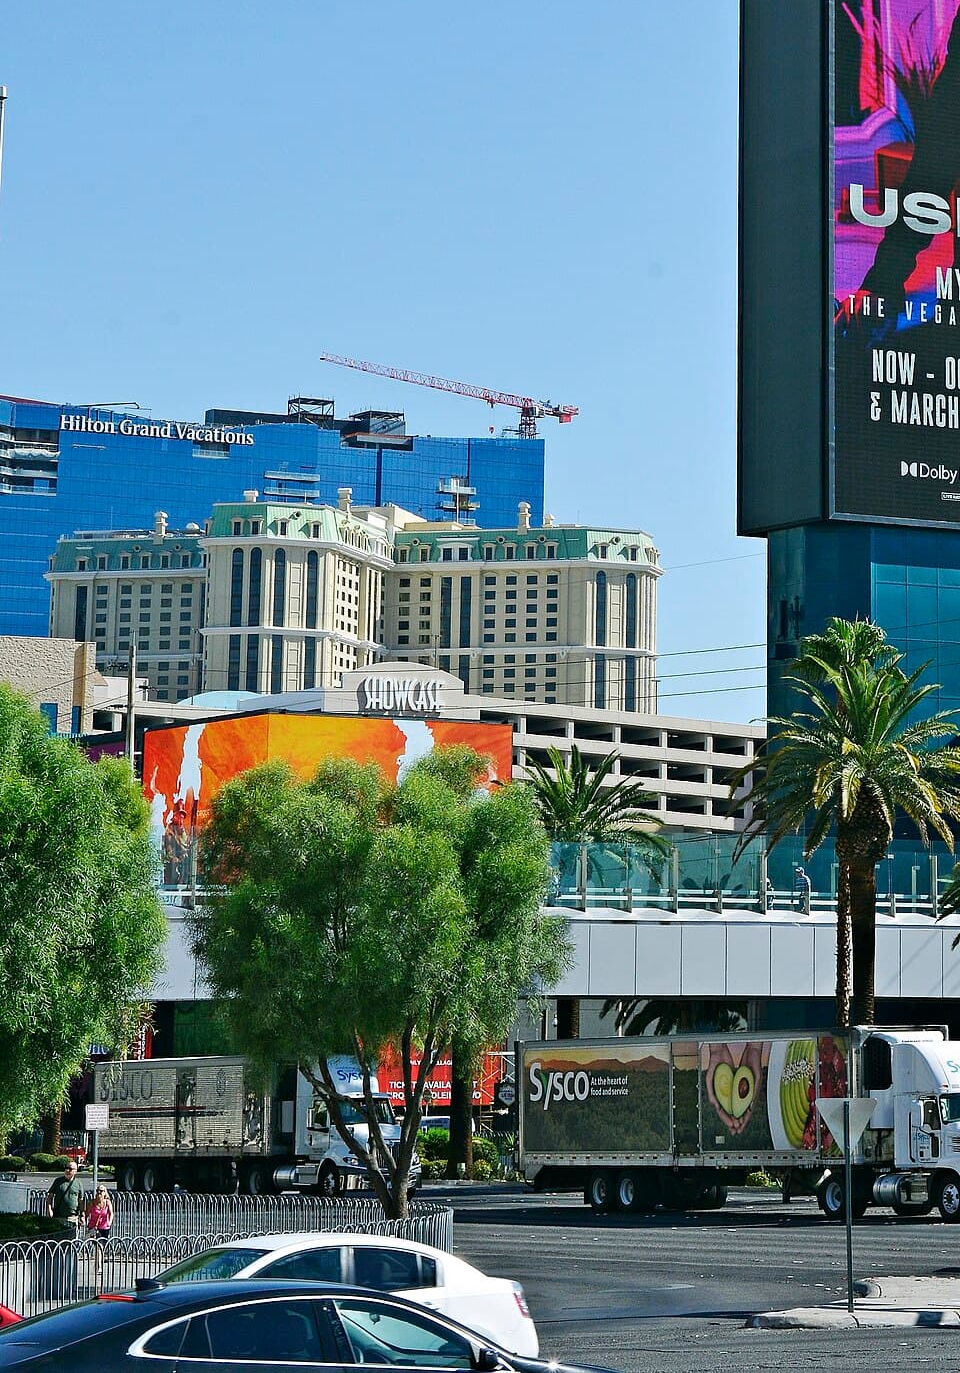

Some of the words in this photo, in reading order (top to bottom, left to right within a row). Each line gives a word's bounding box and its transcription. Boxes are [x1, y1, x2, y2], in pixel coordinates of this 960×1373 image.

[848, 294, 886, 318] THE
[872, 349, 916, 386] NOW
[870, 391, 882, 422] &
[891, 390, 960, 429] MARCH
[60, 414, 117, 435] Hilton
[119, 419, 171, 438] Grand
[174, 422, 255, 445] Vacations
[919, 462, 958, 484] Dolby
[364, 676, 446, 712] SHOWCASE
[337, 1069, 363, 1084] Sysc
[606, 1076, 621, 1085] heart
[590, 1088, 601, 1096] food
[611, 1087, 629, 1095] service
